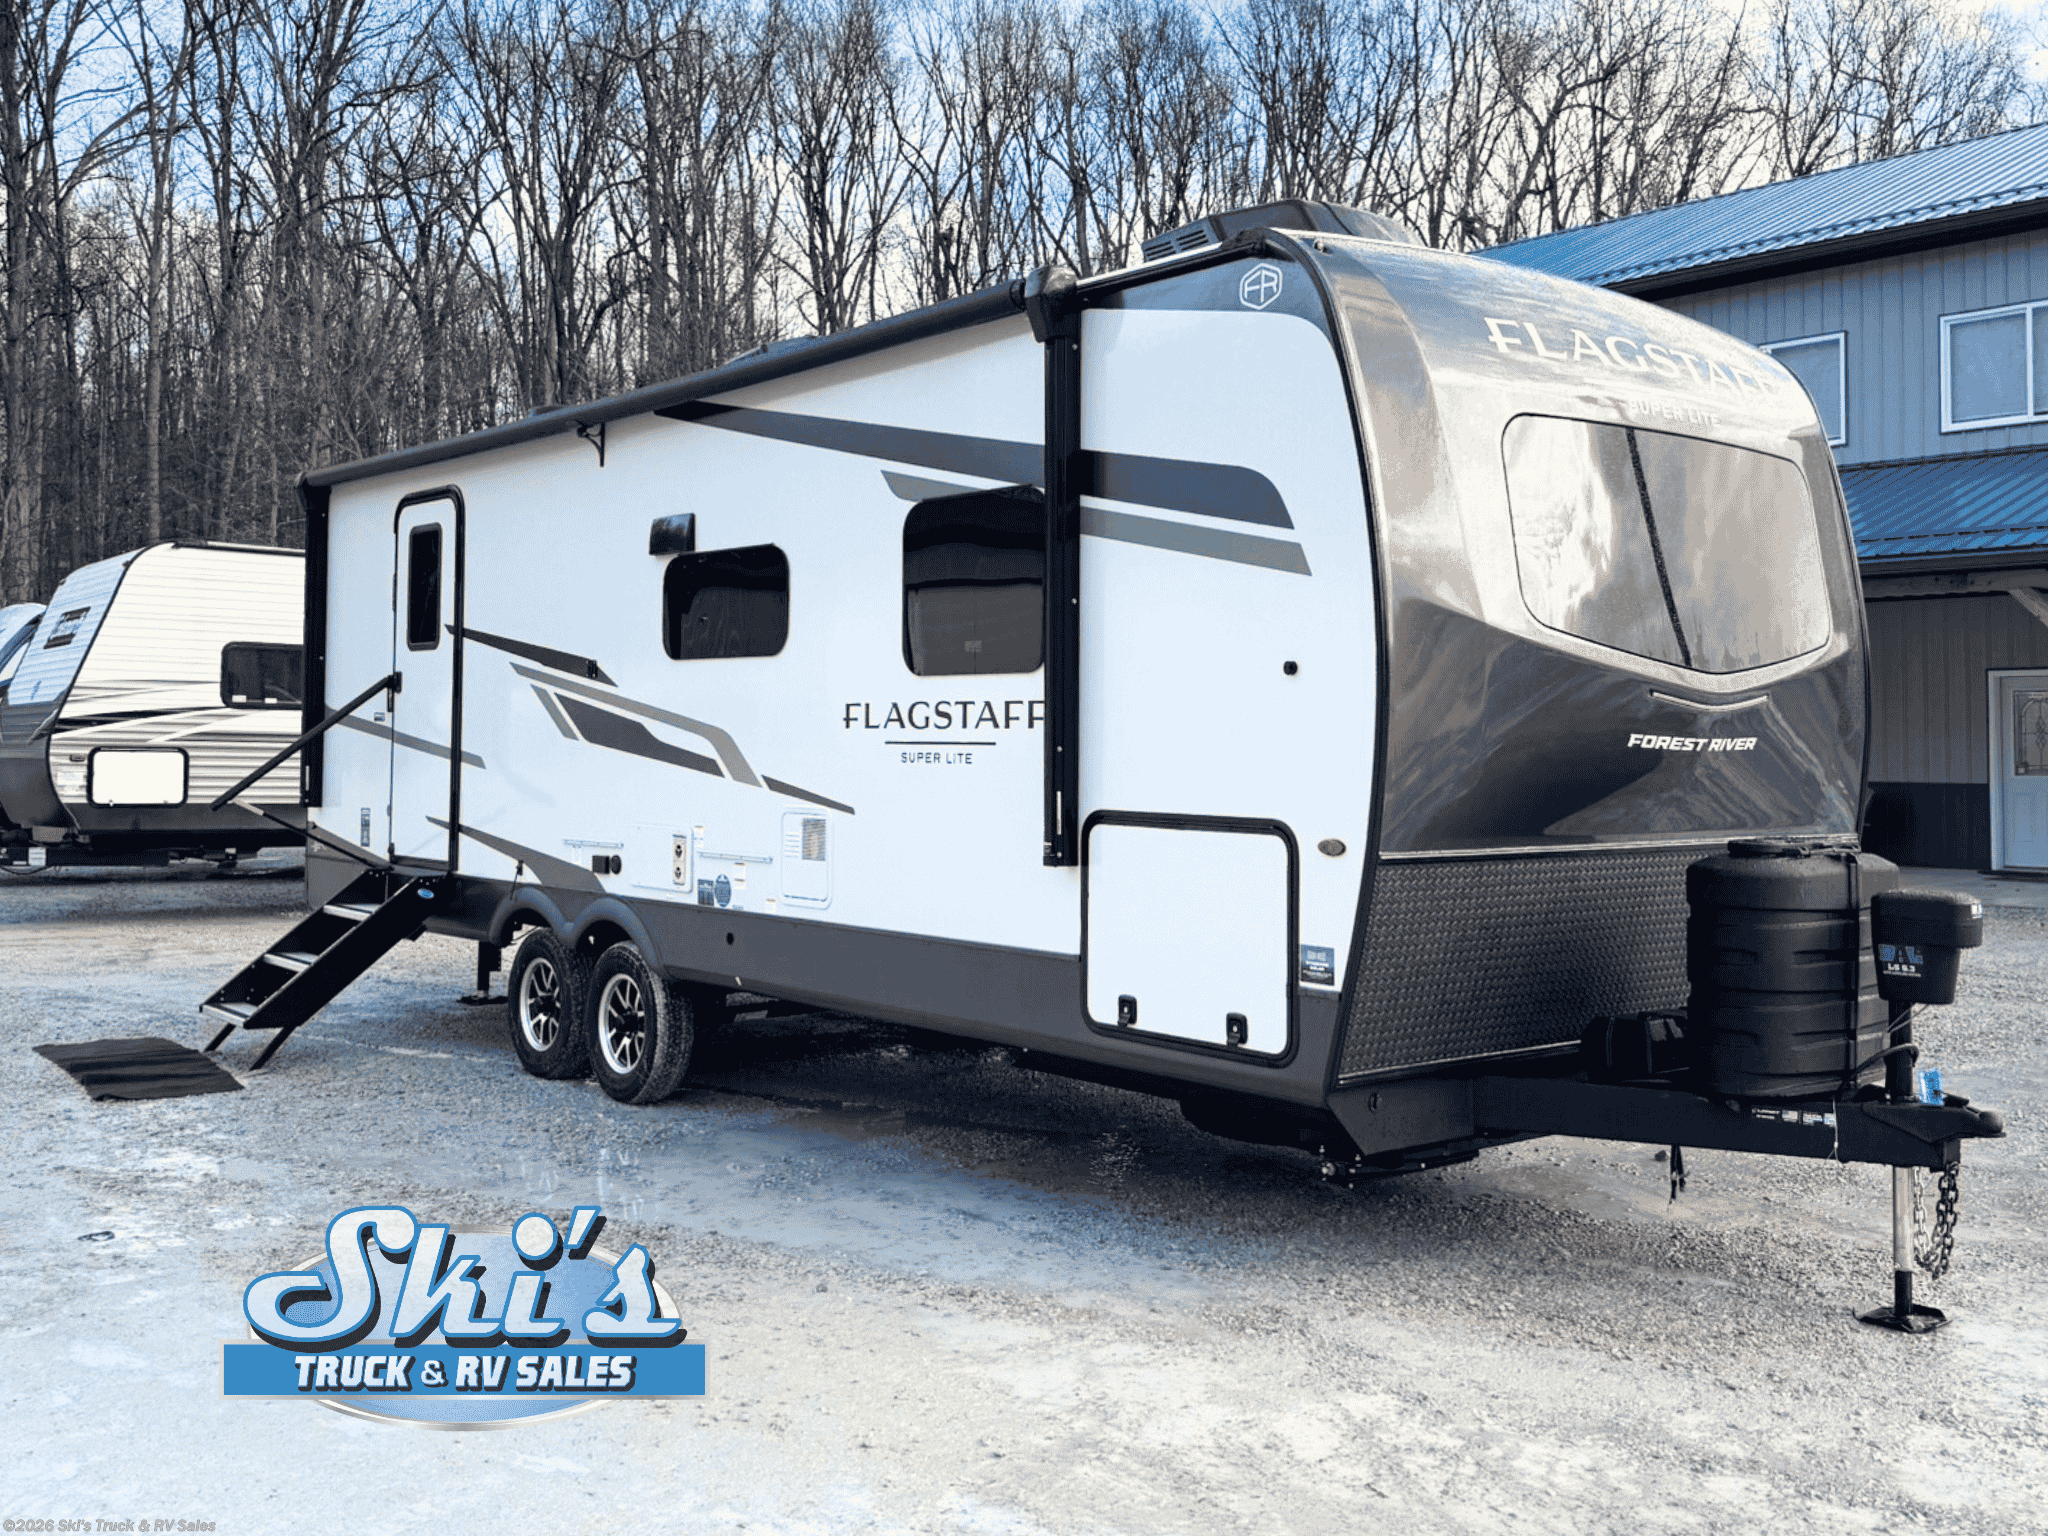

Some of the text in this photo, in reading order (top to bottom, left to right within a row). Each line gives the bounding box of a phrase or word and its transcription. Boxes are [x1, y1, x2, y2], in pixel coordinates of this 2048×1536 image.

[1627, 399, 1721, 428] SUPER LITE
[843, 700, 1045, 730] FLAGSTAFF
[1627, 733, 1758, 751] FOREST RIVER
[900, 752, 973, 764] SUPER LITE
